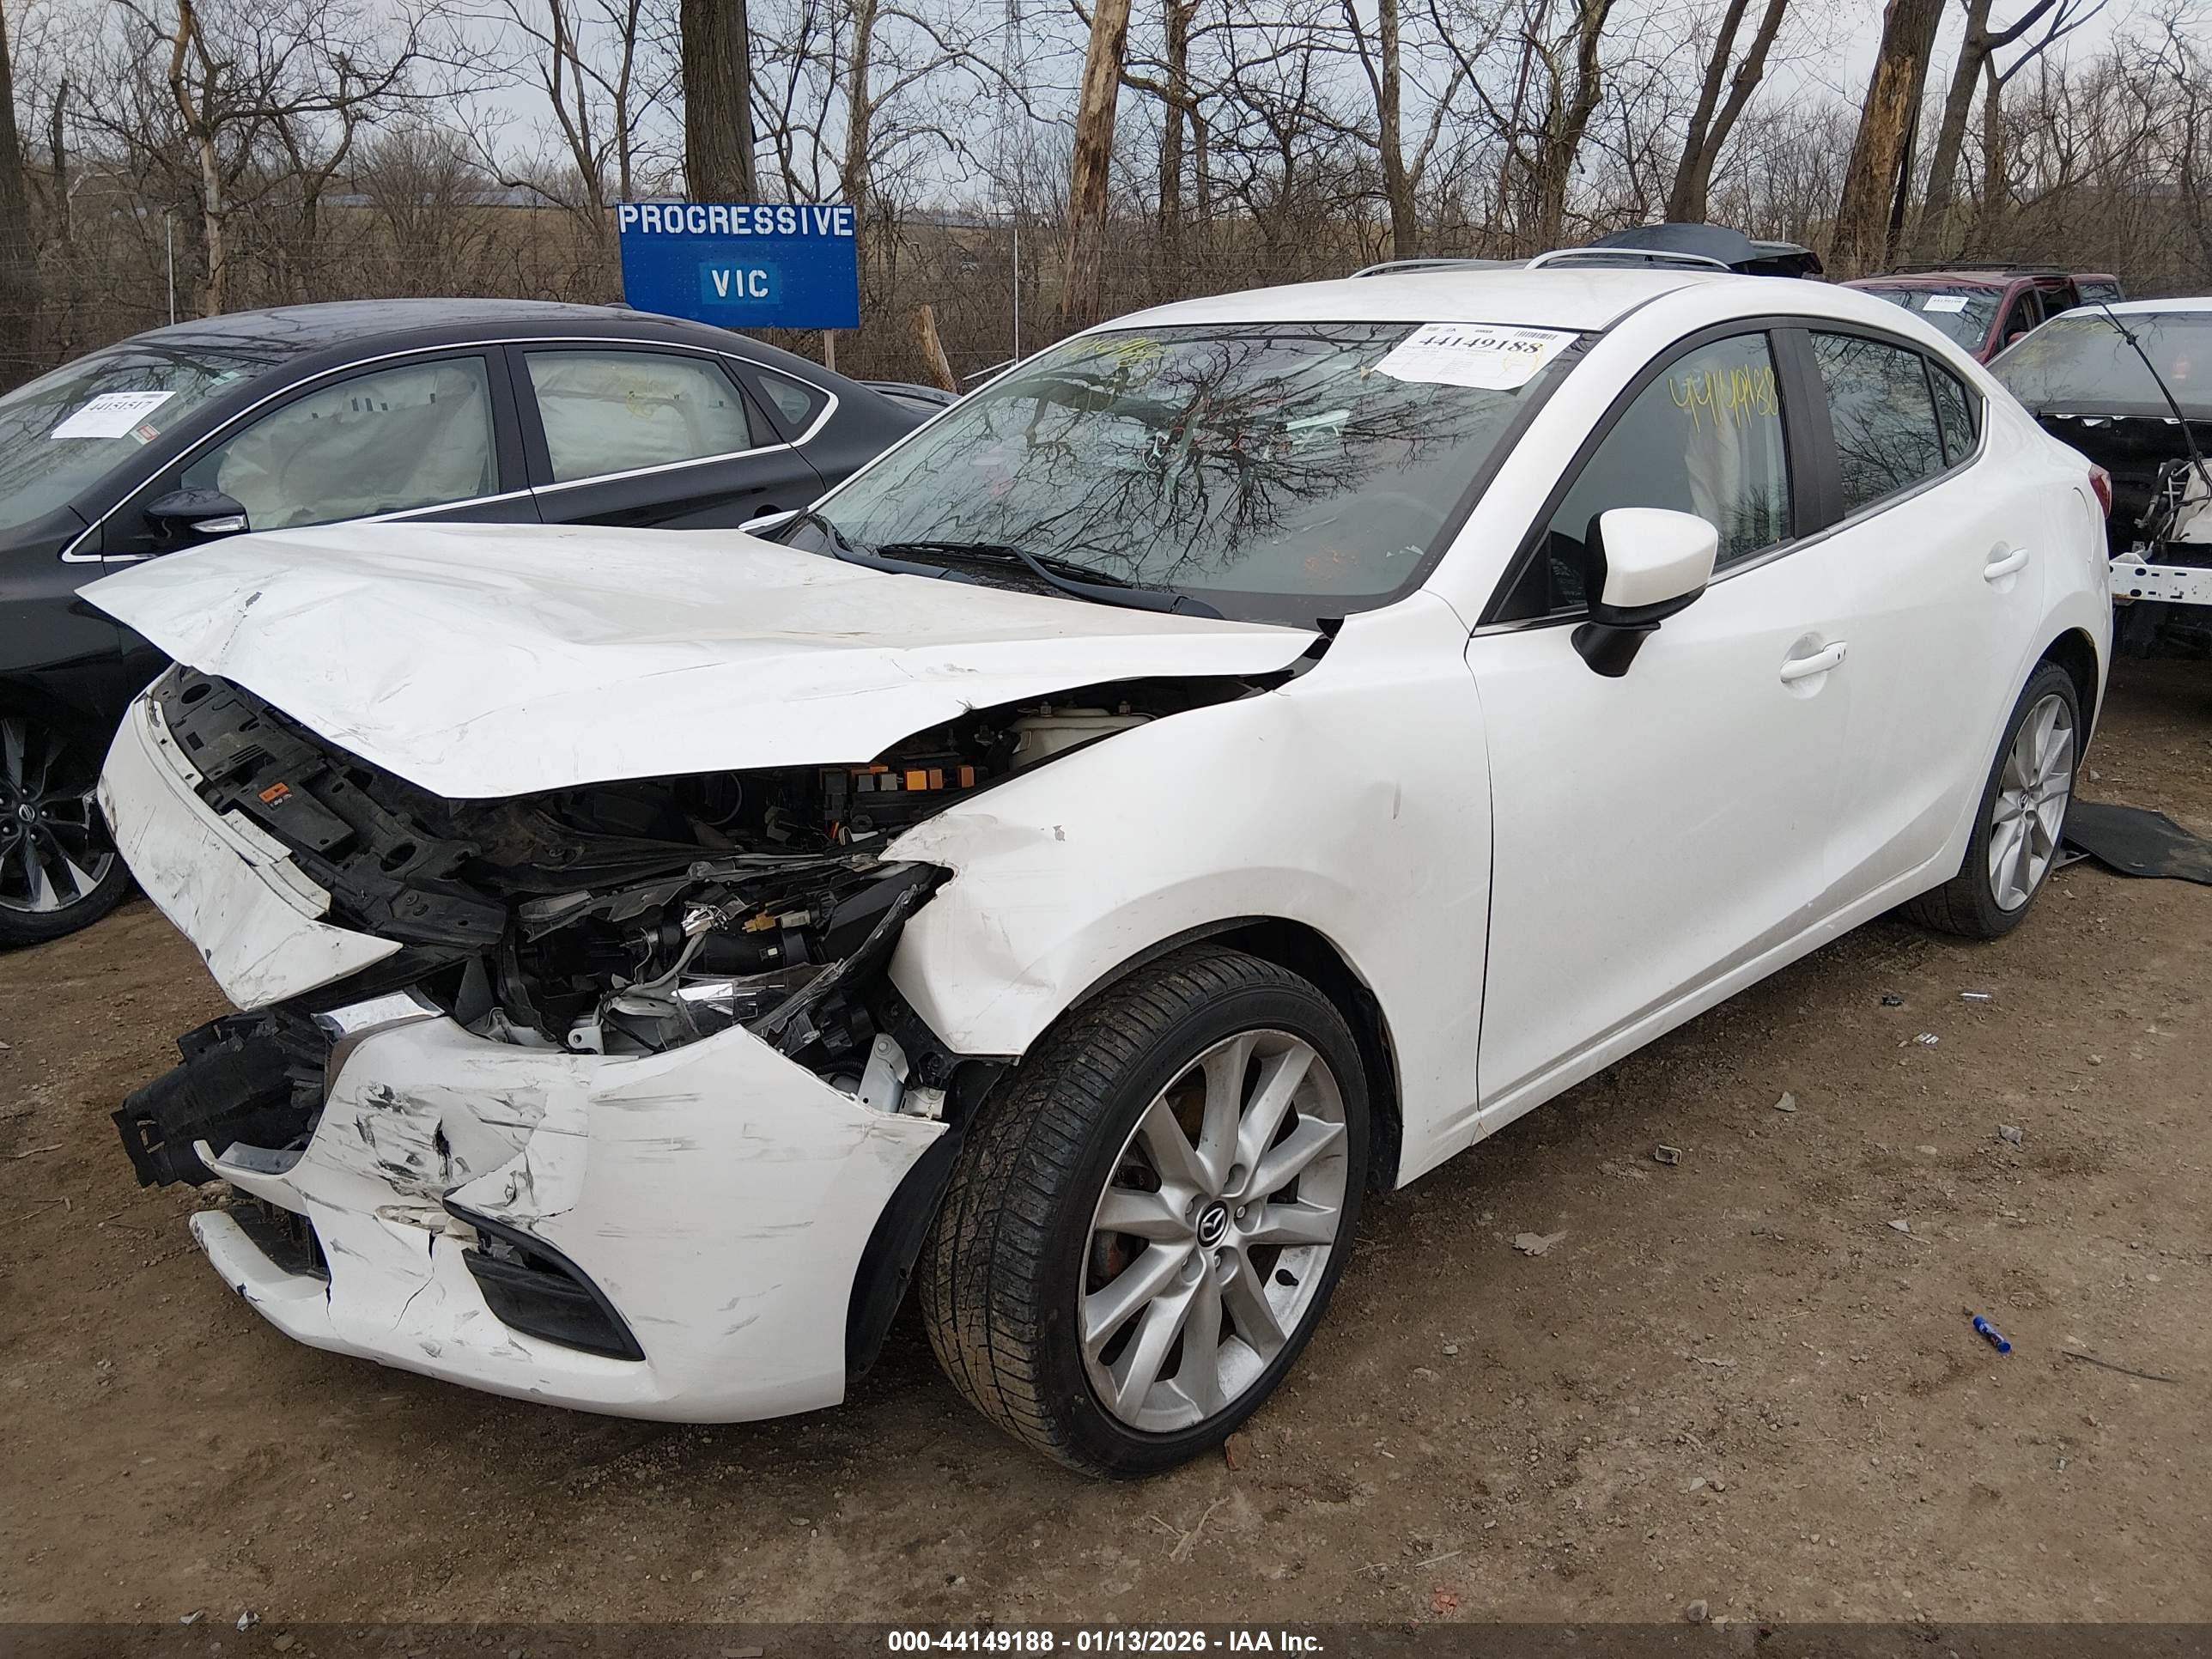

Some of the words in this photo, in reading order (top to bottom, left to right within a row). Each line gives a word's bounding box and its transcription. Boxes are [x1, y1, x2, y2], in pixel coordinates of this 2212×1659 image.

[618, 205, 853, 236] PROGRESSIVE
[711, 270, 769, 297] VIC
[1419, 335, 1543, 354] 44149188
